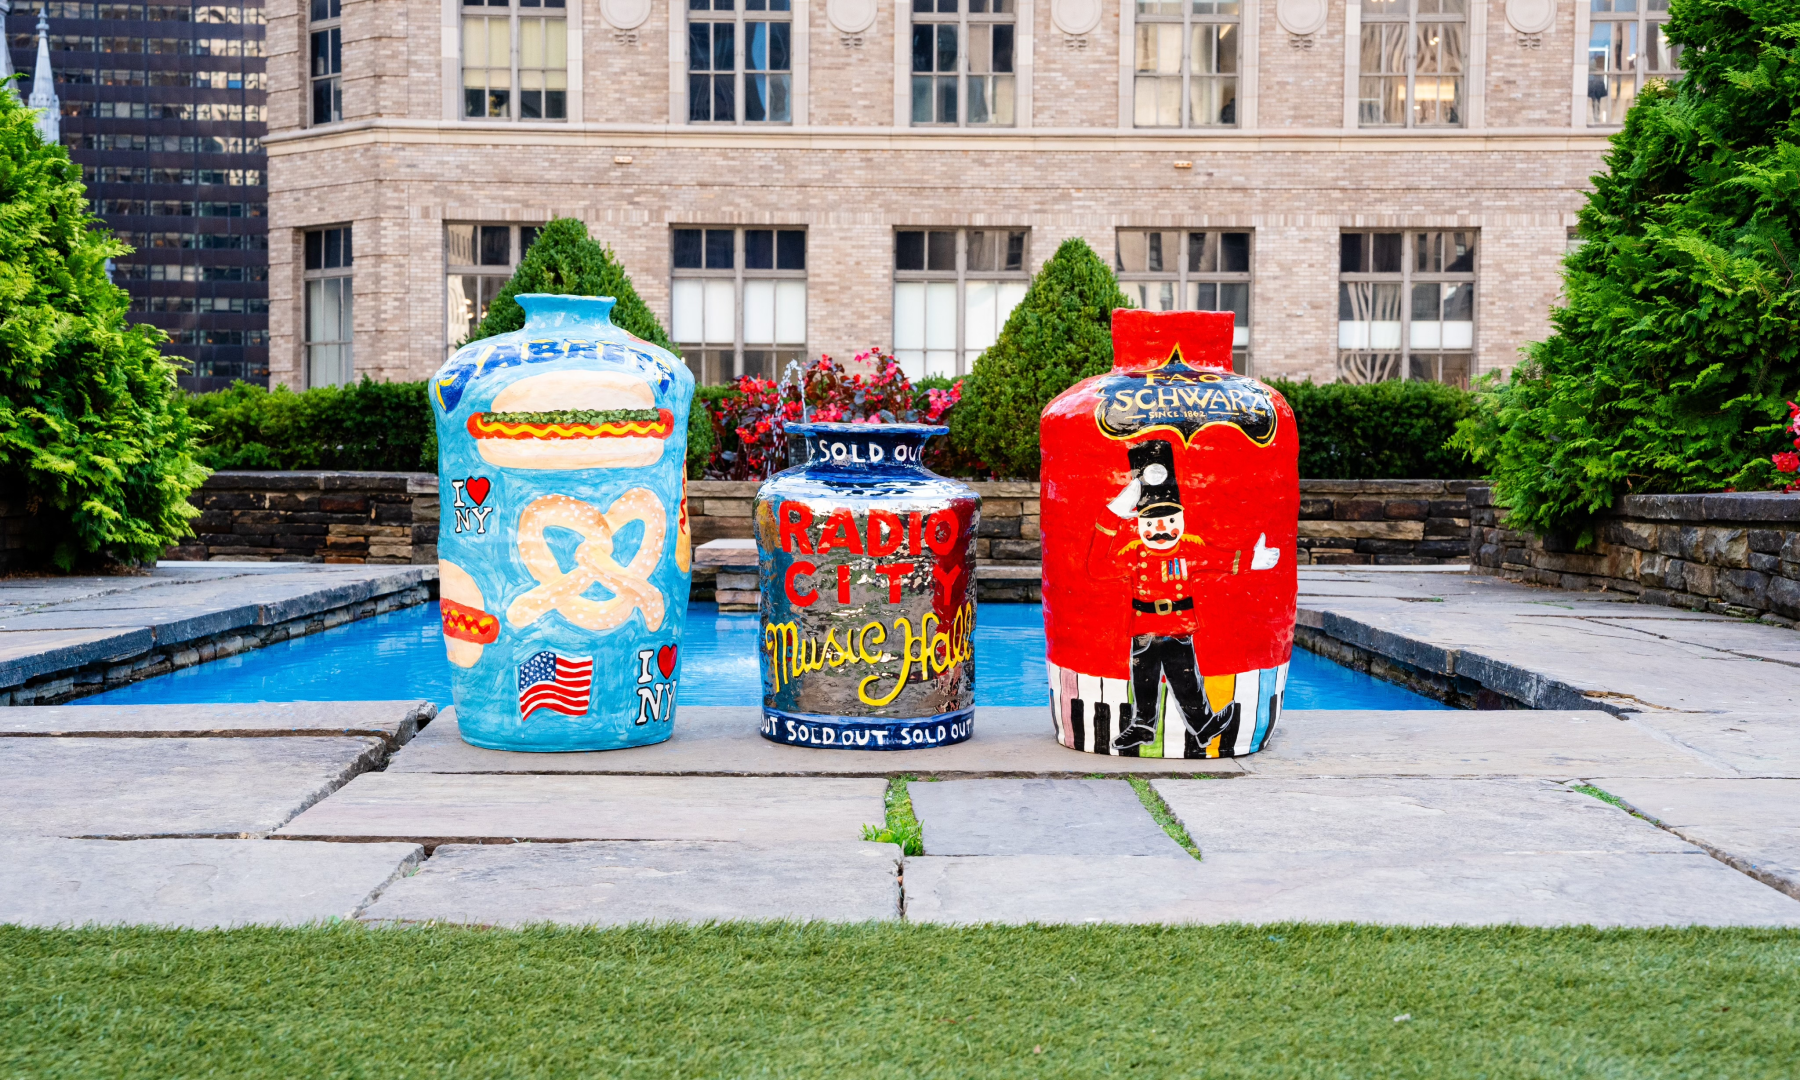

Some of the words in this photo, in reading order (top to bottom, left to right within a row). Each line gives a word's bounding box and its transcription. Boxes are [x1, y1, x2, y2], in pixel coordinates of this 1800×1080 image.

[1110, 387, 1266, 417] SCHWARZ
[1148, 411, 1179, 420] SINCE
[1183, 410, 1206, 418] 1862
[819, 439, 884, 463] SOLD
[454, 506, 493, 534] NY
[779, 500, 959, 557] RADIO
[784, 560, 962, 607] CITY
[765, 620, 887, 694] Music
[858, 601, 973, 706] Hall
[635, 680, 677, 725] NY
[786, 720, 835, 745] SOLD
[841, 730, 889, 745] OUT
[901, 725, 947, 745] SOLD
[951, 718, 972, 740] OUT
